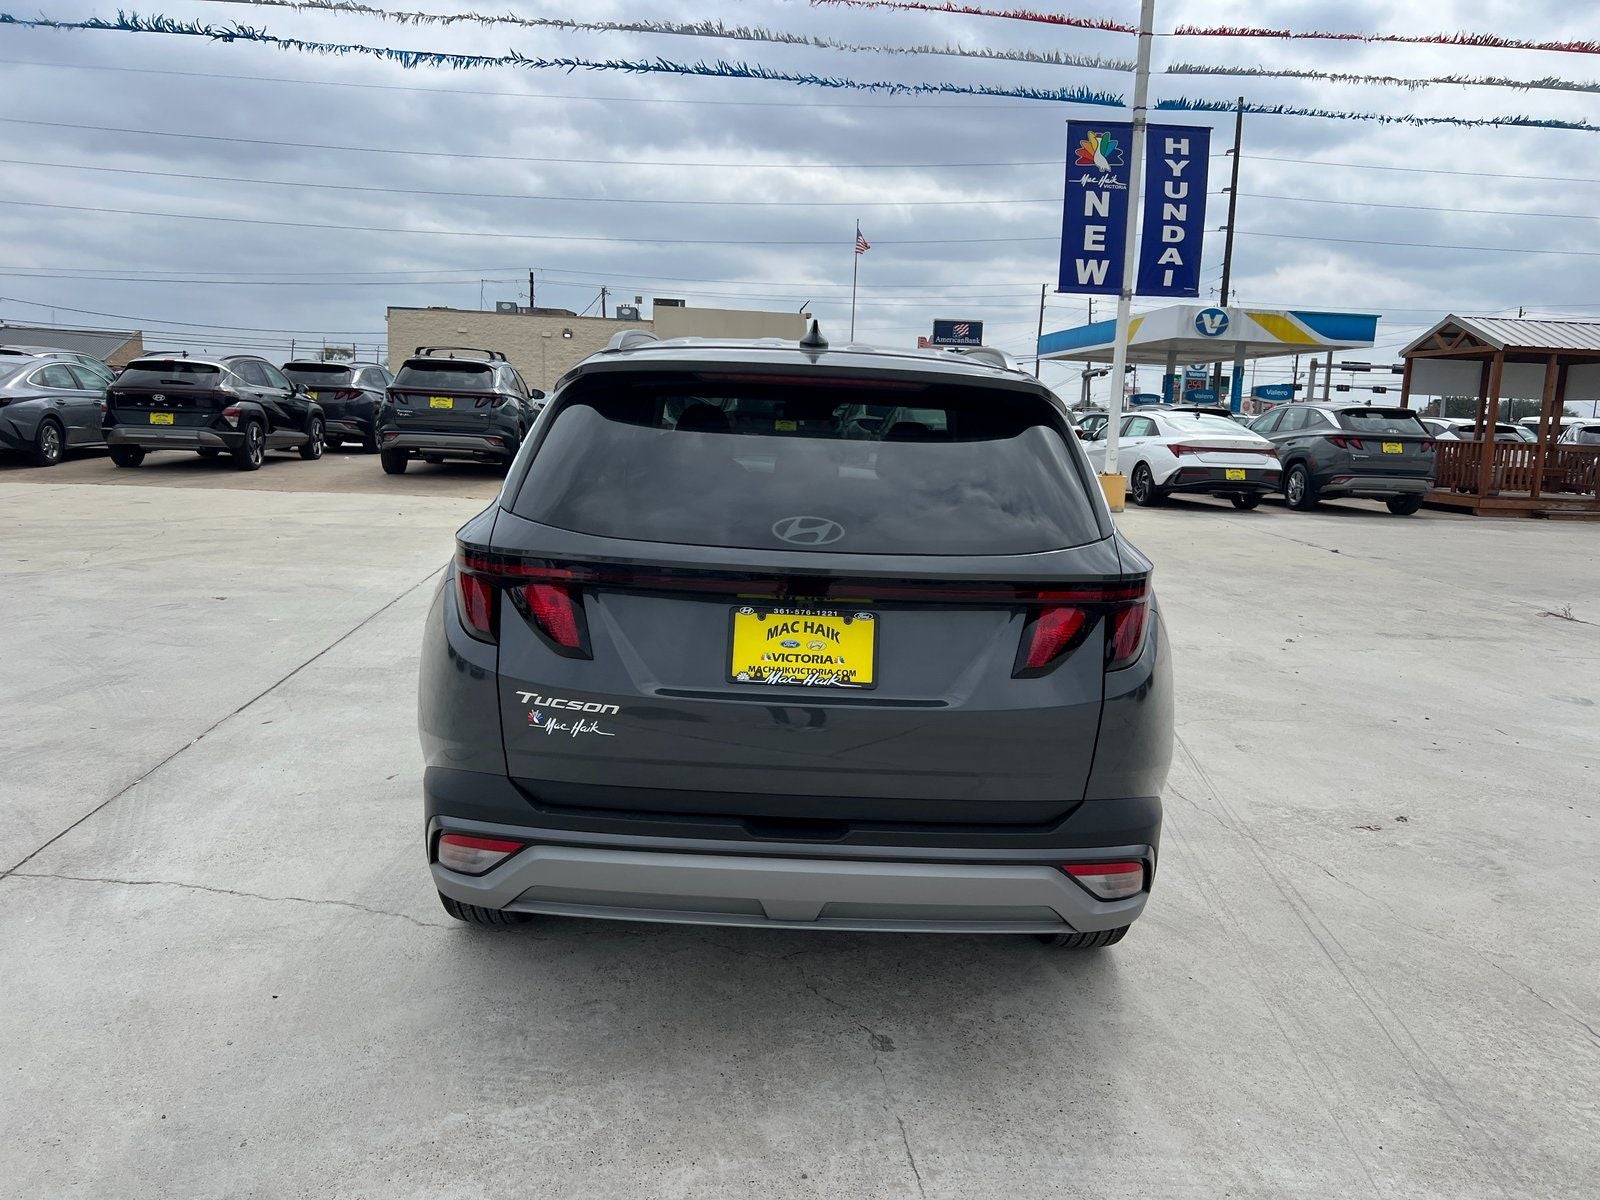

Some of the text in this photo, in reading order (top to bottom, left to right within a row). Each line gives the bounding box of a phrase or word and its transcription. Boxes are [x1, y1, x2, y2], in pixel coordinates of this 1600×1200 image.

[1072, 173, 1125, 188] Mac Haik
[1157, 137, 1190, 287] HYUNDAI
[1075, 190, 1110, 286] NEW
[1266, 388, 1288, 396] Valero
[766, 620, 841, 644] MAC HAIK
[771, 652, 834, 665] VICTORIA
[757, 671, 856, 687] Mac Haik
[535, 717, 614, 738] Mac Haik
